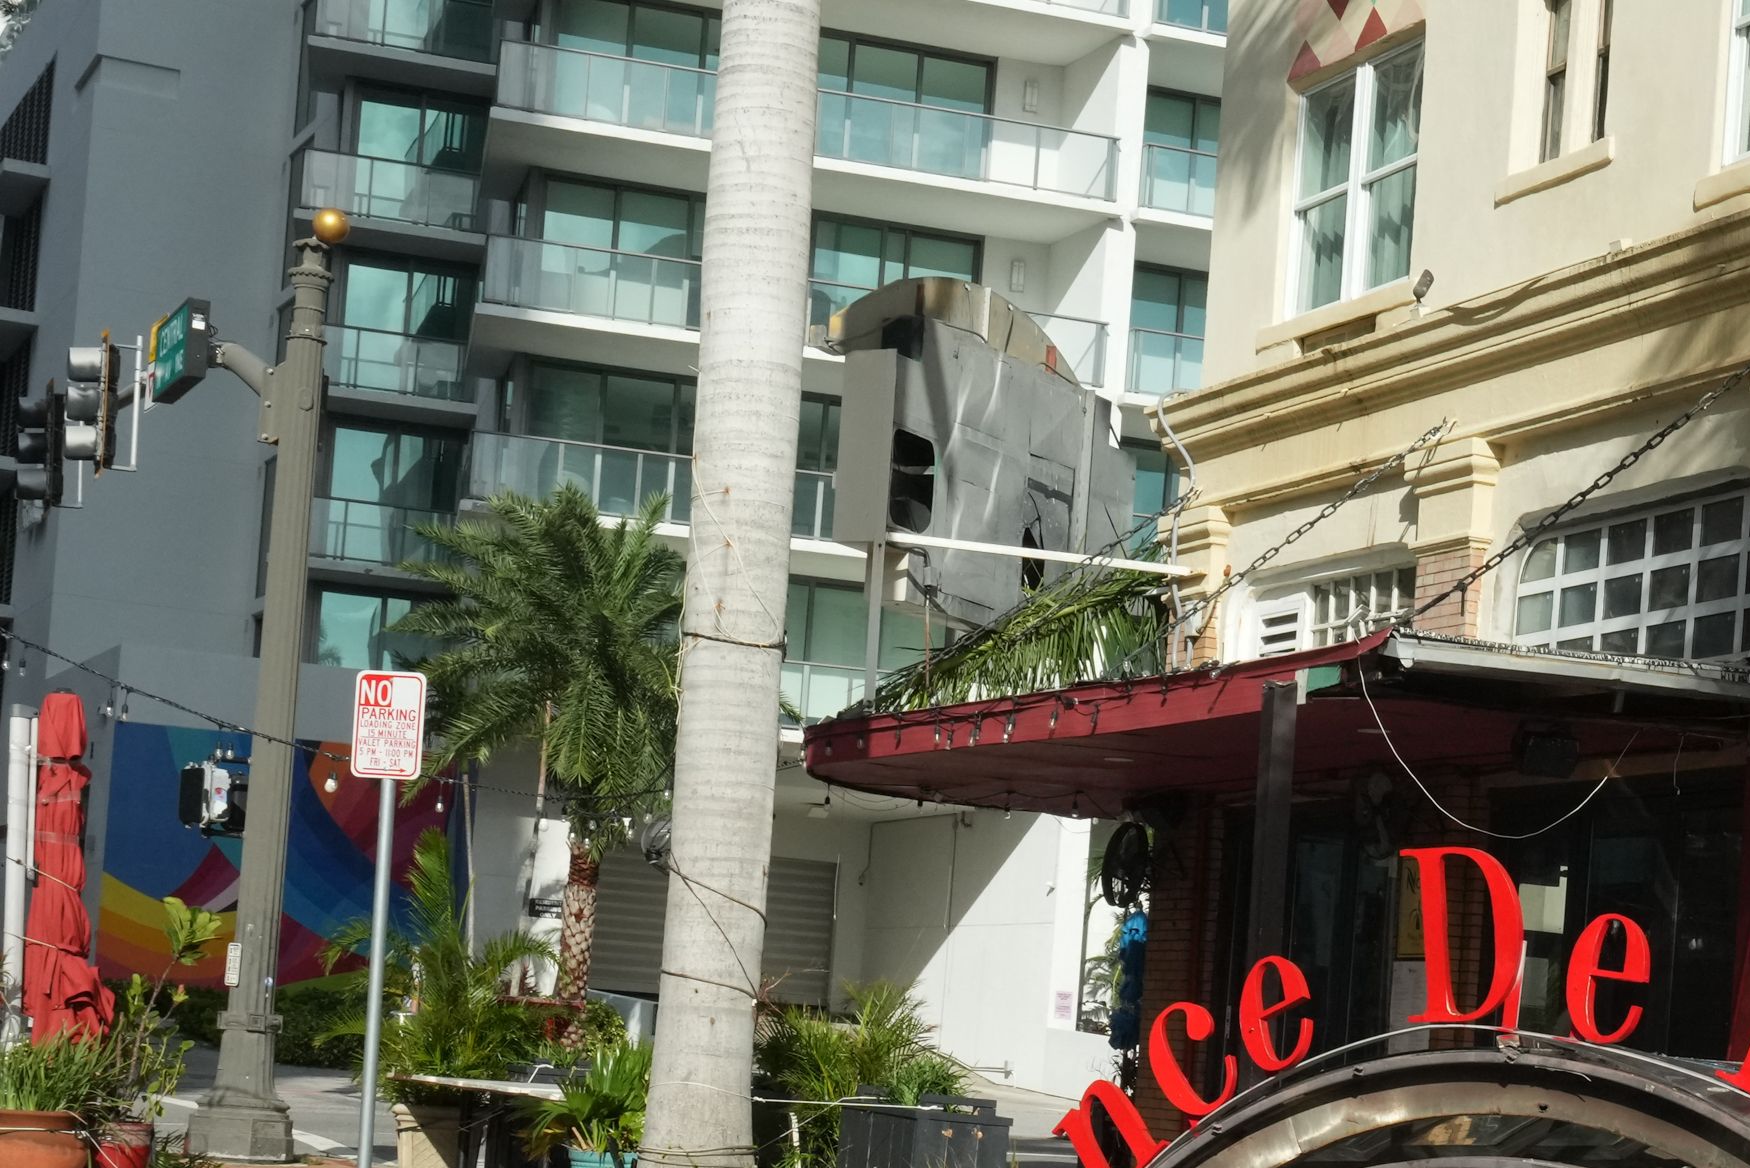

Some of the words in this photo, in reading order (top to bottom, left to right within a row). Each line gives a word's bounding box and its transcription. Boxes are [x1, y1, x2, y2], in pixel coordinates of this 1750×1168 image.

[360, 680, 392, 706] NO
[362, 707, 417, 721] PARKING
[360, 720, 392, 729] LOADING
[396, 720, 416, 730] ZONE
[367, 729, 376, 737] 15
[377, 730, 407, 739] MINUTE
[359, 738, 380, 747] VALET
[384, 739, 416, 749] PARKING
[403, 750, 414, 758] PM
[389, 759, 401, 768] SAT
[1401, 846, 1651, 1044] De
